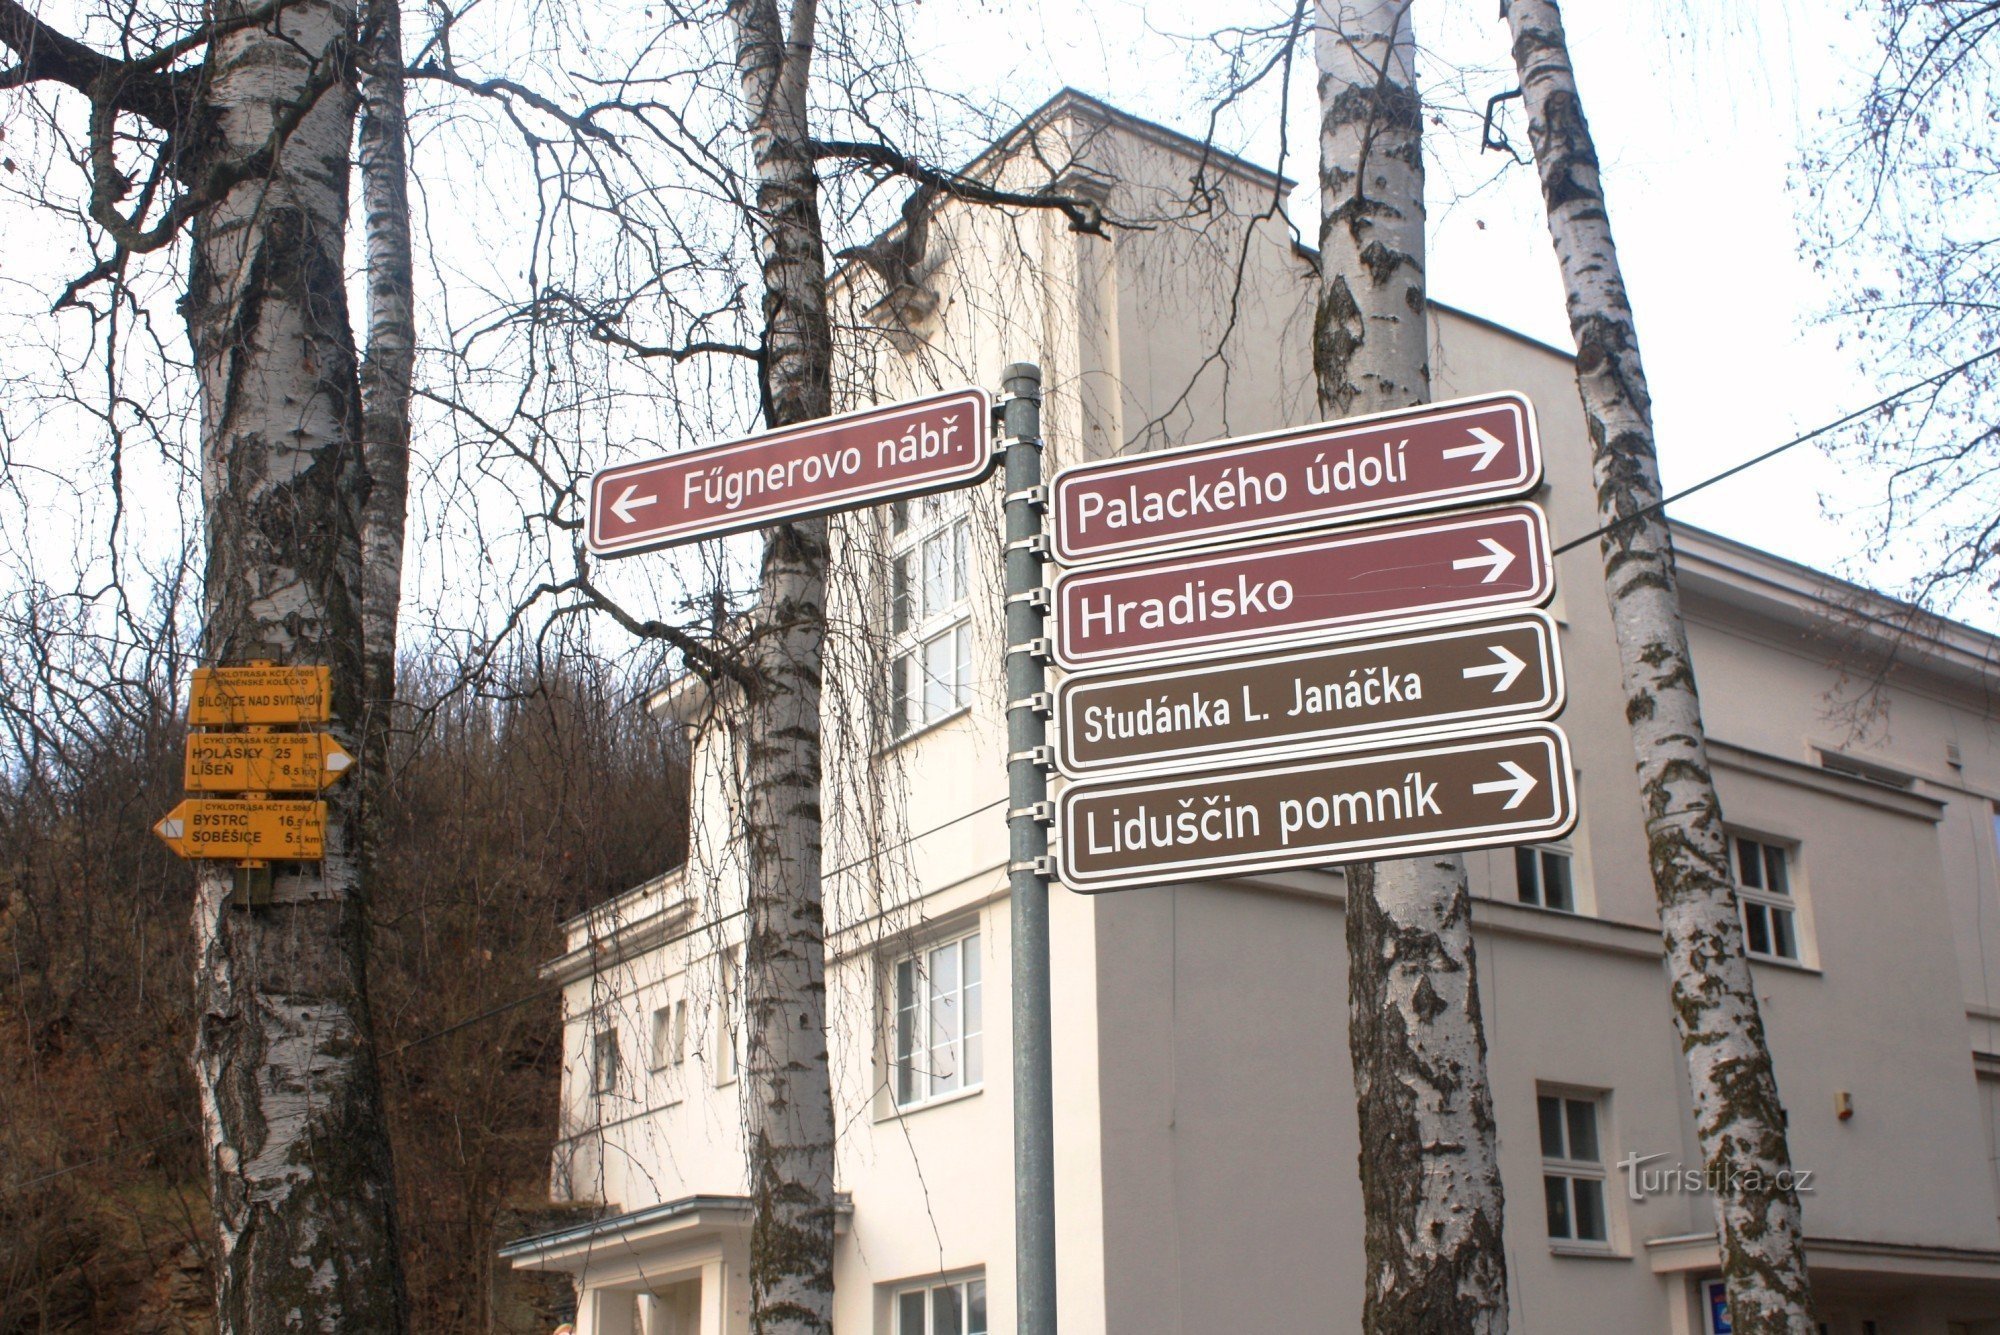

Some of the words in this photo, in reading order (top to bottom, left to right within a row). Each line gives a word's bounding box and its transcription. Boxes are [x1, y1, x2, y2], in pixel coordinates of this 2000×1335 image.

[877, 414, 963, 469] nábř.
[1078, 466, 1288, 534] Palackého
[1306, 440, 1409, 496] údolí
[1081, 574, 1294, 638] Hradisko
[208, 670, 267, 678] YKLOTRASA
[248, 695, 270, 706] NAD
[273, 694, 323, 706] SVITAVOU
[1084, 694, 1230, 744] Studánka
[1243, 684, 1270, 723] L.
[1287, 666, 1423, 718] Janáčka
[192, 745, 263, 759] HOLÁSKY
[275, 748, 291, 759] 25
[191, 762, 234, 775] LÍŠEŇ
[205, 804, 264, 812] CYKLOTRASA
[1087, 795, 1261, 856] Liduščin
[1280, 772, 1443, 845] pomník
[193, 814, 248, 826] BYSTRC
[305, 817, 320, 827] km
[192, 829, 262, 843] SOBĚŠICE
[304, 834, 320, 844] km
